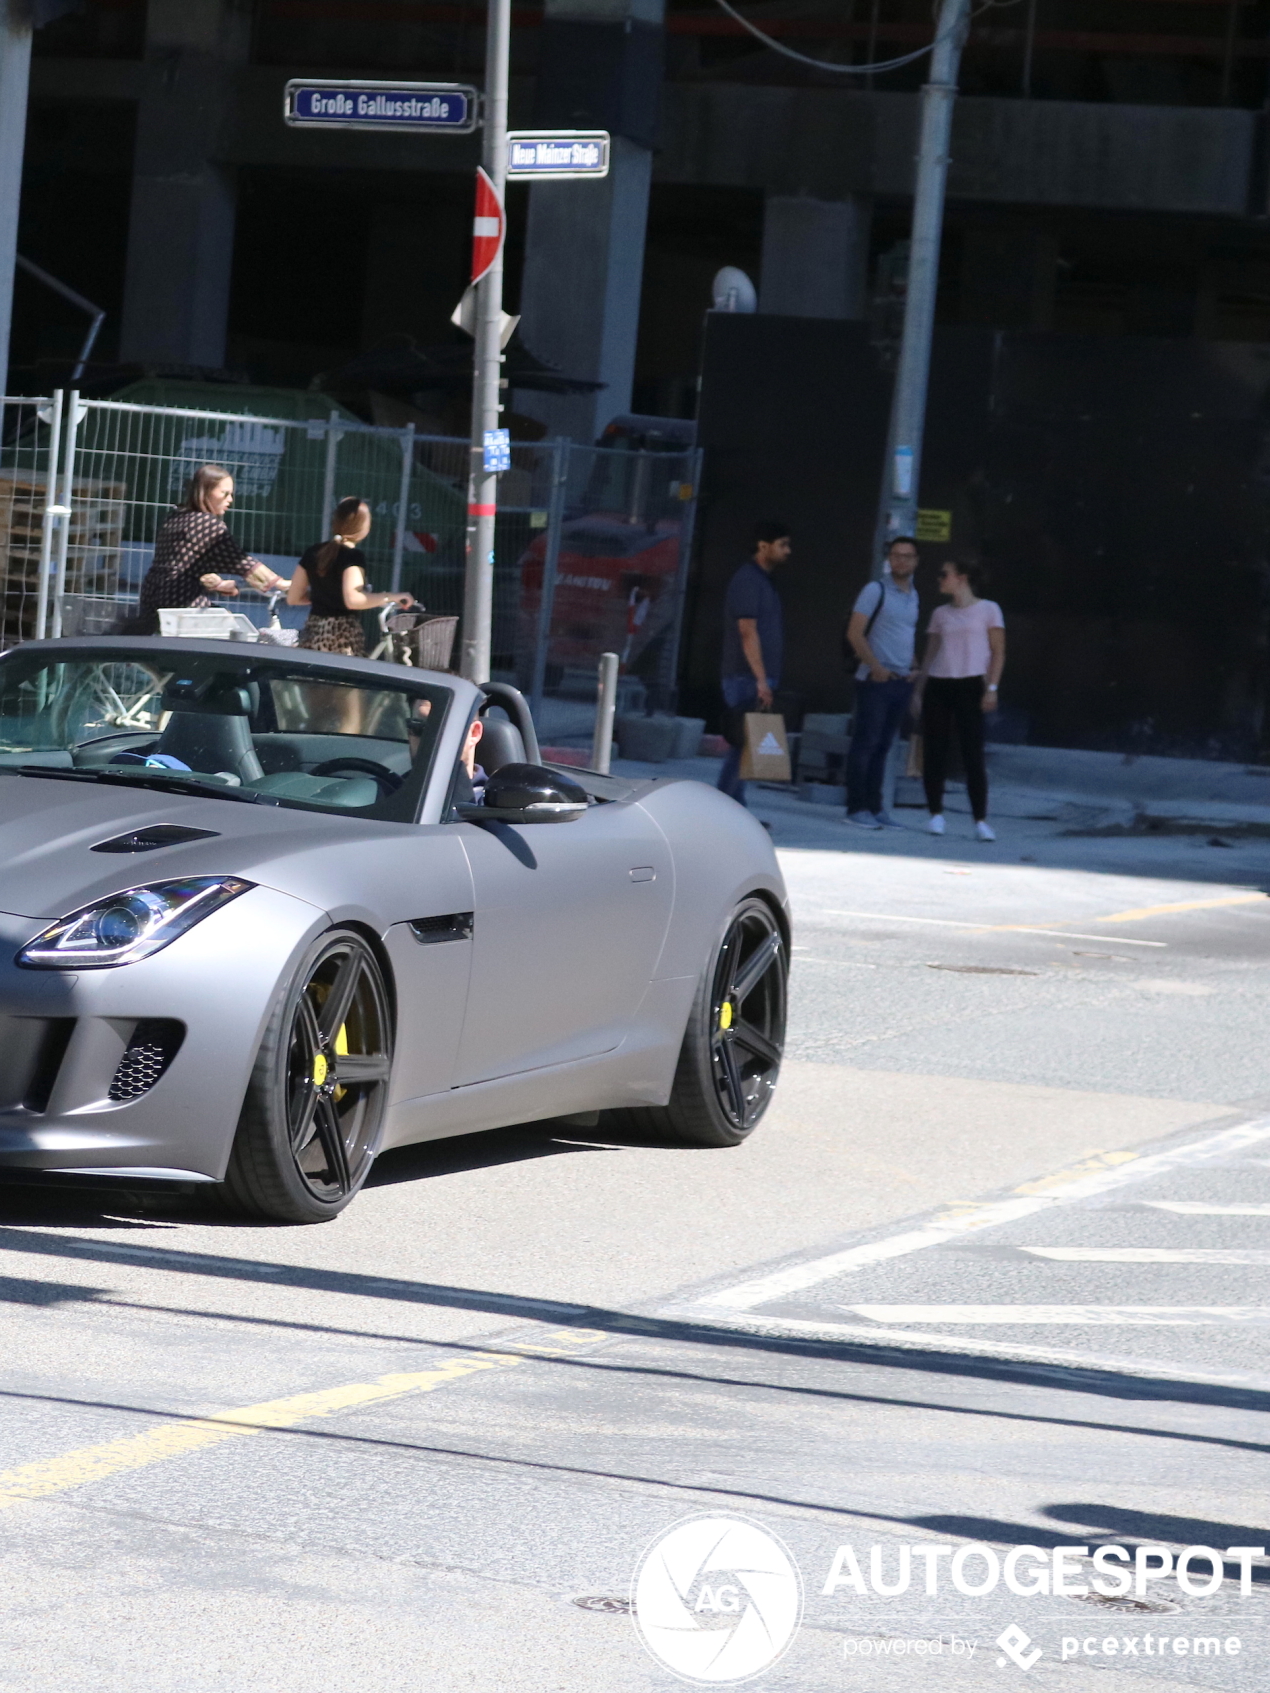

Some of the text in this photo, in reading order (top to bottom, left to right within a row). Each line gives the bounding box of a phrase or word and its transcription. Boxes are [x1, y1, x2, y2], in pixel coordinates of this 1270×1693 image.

[310, 92, 450, 119] Große Gallusstraße
[512, 143, 599, 167] Neue Mainzer Straße
